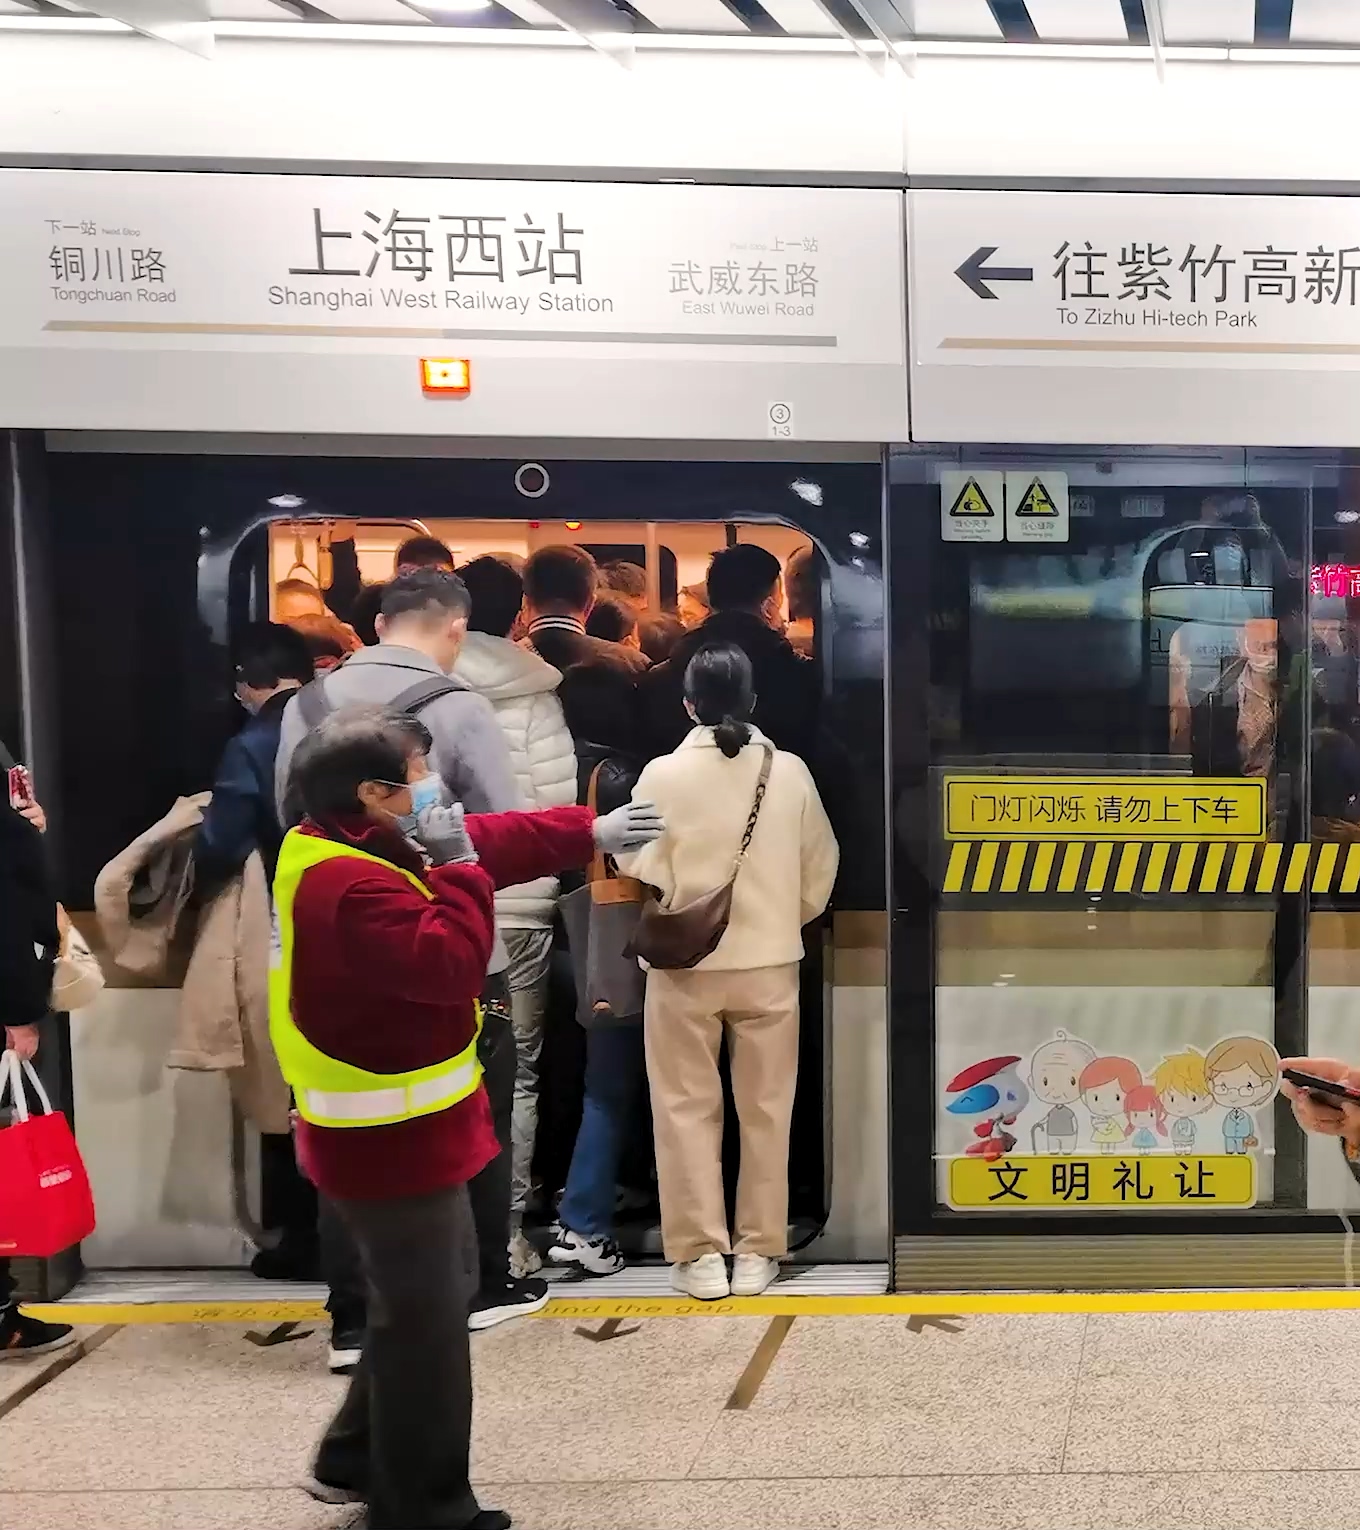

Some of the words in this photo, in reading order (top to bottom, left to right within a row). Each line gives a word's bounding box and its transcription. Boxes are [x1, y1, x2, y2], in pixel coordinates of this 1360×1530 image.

[44, 219, 97, 236] 下一站
[288, 207, 584, 286] 上海西站
[769, 236, 819, 253] 上一站
[48, 245, 167, 283] 铜川路
[668, 260, 819, 297] 武威东路
[50, 286, 132, 304] Tongchuan
[136, 288, 177, 303] Road
[268, 285, 373, 312] Shanghai
[380, 288, 438, 309] West
[444, 289, 530, 316] Railway
[538, 291, 614, 313] Station
[682, 300, 715, 314] East
[719, 300, 770, 316] Wuwei
[775, 302, 815, 316] Road
[1056, 307, 1079, 325] To
[1084, 308, 1136, 327] Zizhu
[1142, 309, 1208, 327] Hi-tech
[1215, 310, 1258, 328] Park
[771, 425, 792, 437] 1-3
[970, 794, 1086, 823] 门灯闪烁
[1094, 795, 1239, 825] 请勿上下车
[987, 1160, 1216, 1202] 文明礼让
[613, 1303, 662, 1312] the
